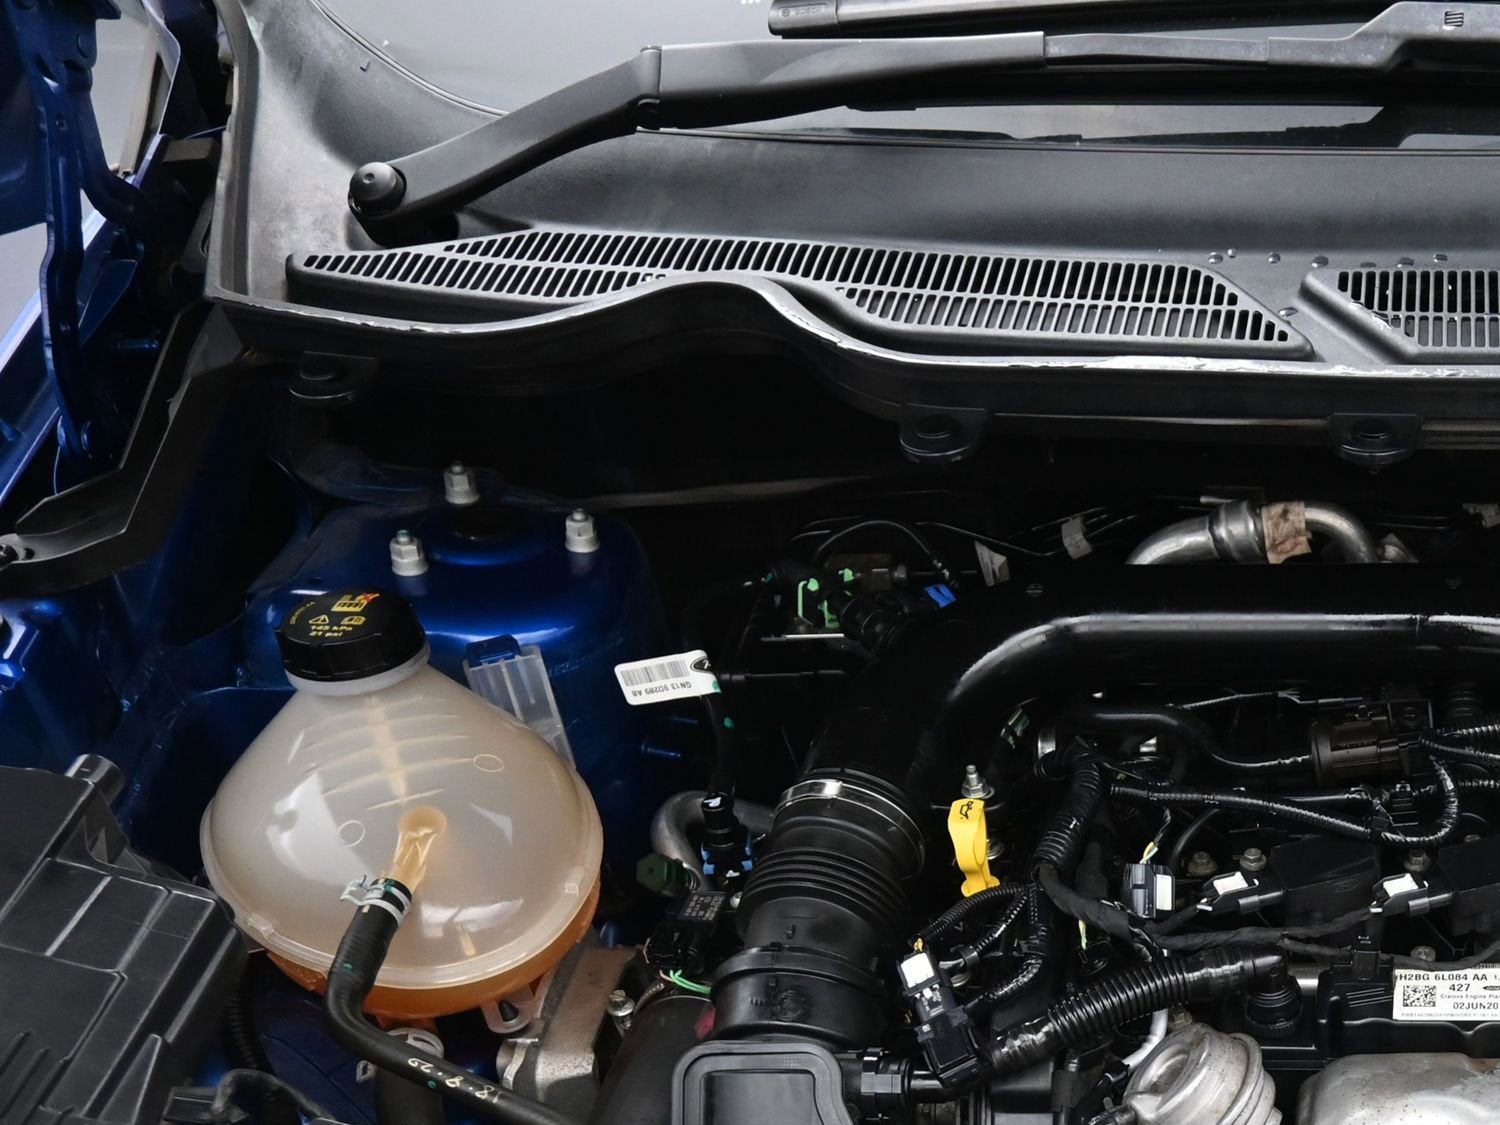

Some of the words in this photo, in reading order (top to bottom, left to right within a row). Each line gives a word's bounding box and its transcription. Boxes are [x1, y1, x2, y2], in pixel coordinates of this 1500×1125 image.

[1434, 973, 1468, 981] 6L084
[1472, 973, 1488, 981] AA
[1449, 983, 1471, 992] 427
[1453, 1002, 1499, 1010] 02JUN20
